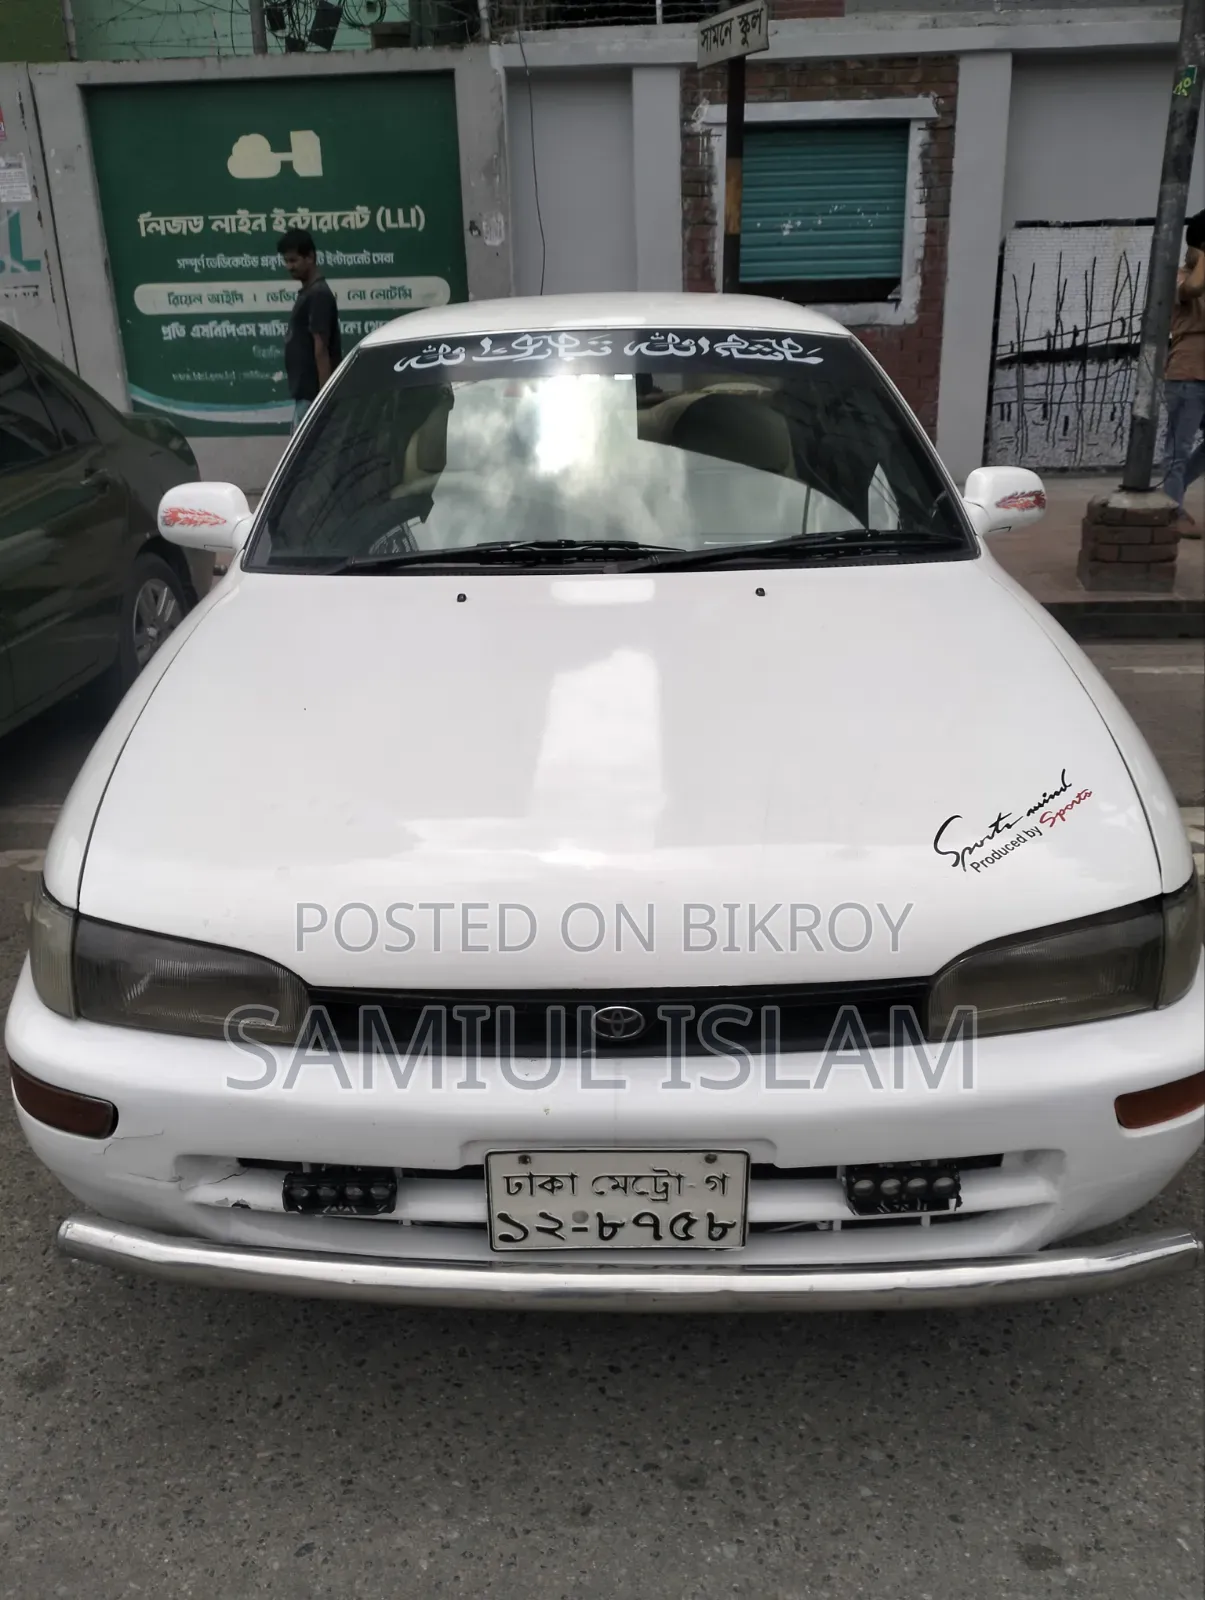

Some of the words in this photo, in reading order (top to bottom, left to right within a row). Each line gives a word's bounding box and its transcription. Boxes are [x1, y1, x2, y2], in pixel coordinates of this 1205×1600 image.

[138, 211, 204, 237] লিজড
[208, 208, 267, 234] লাইন
[376, 205, 426, 232] (LLI)
[969, 834, 1028, 873] Produced
[1024, 825, 1043, 838] by
[1039, 788, 1093, 828] Sports
[503, 1171, 578, 1196] ঢাকা
[497, 1210, 737, 1243] ১২-৮৭৫৮
